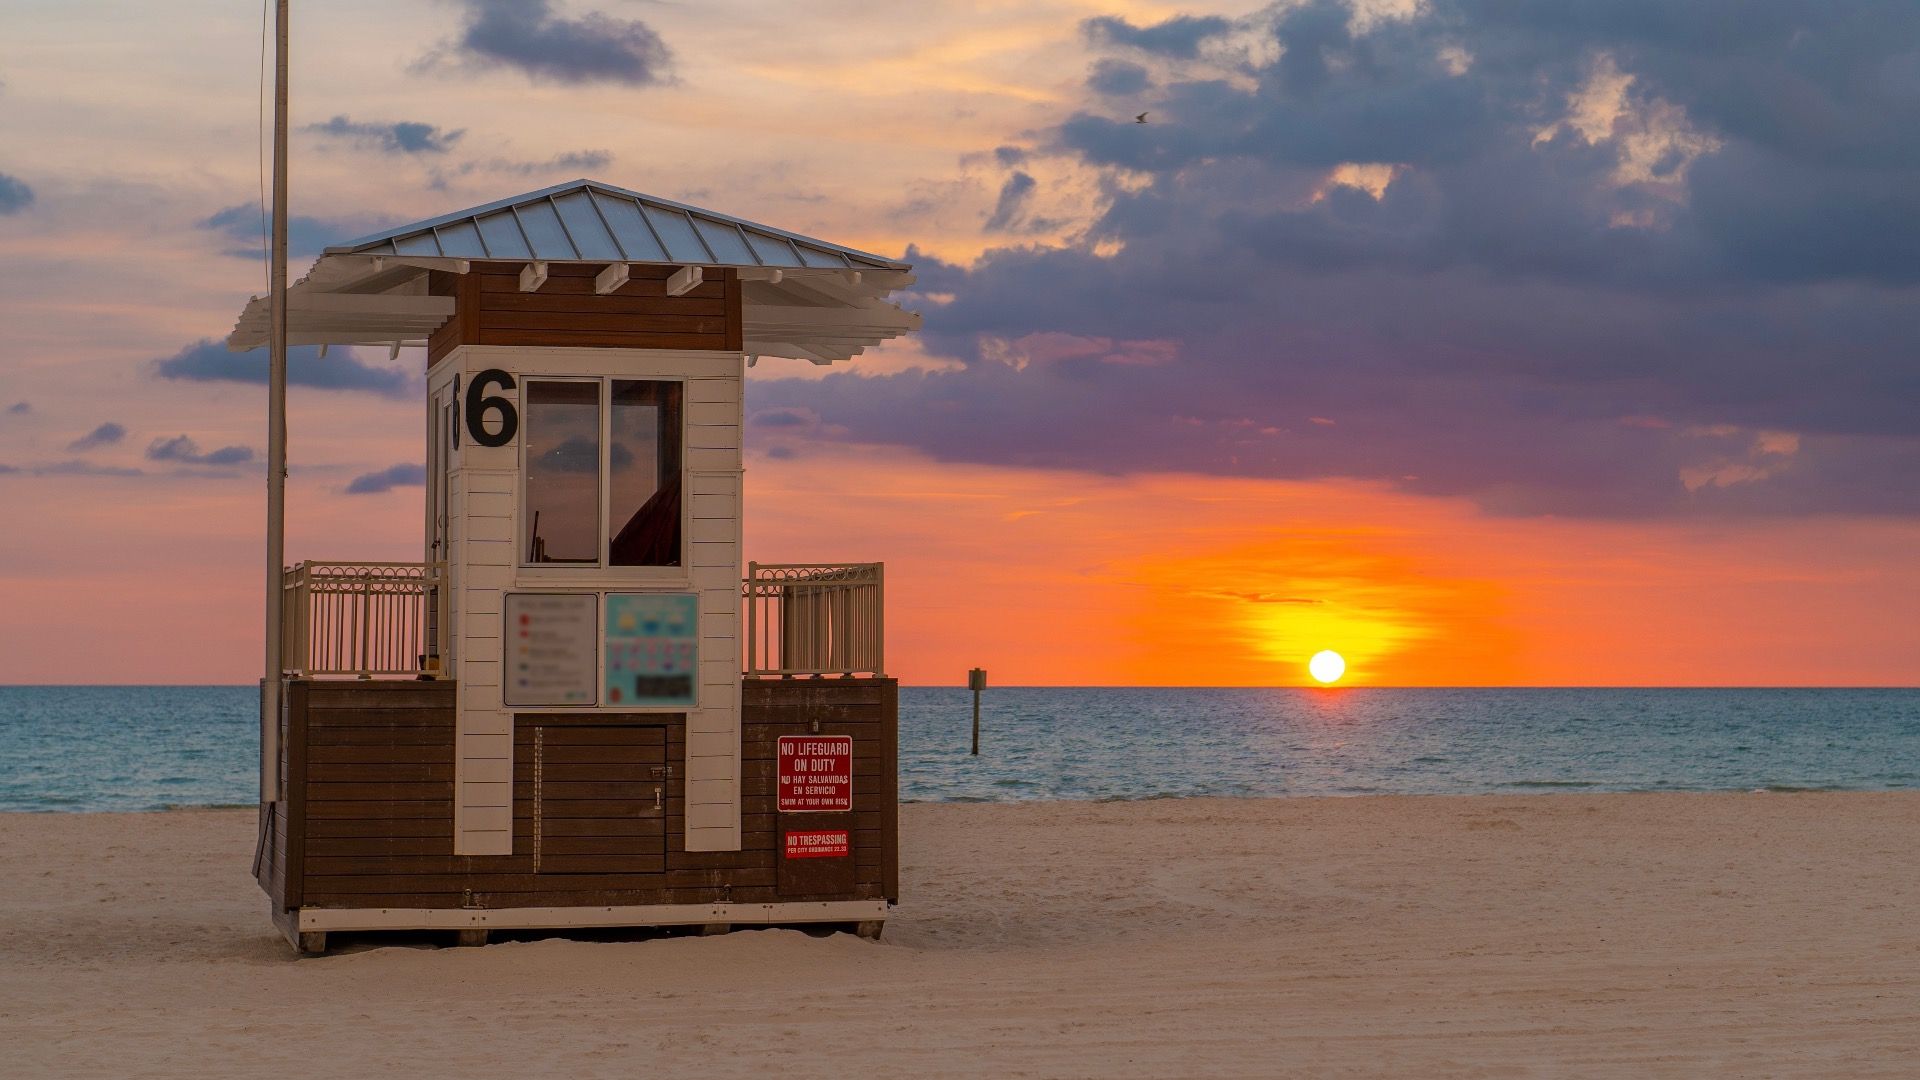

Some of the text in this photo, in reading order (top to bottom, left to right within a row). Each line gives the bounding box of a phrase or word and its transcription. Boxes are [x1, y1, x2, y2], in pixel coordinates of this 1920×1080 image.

[466, 369, 518, 447] 6
[781, 743, 849, 755] NO LIFEGUARD
[794, 758, 835, 771] ON DUTY
[781, 775, 848, 784] NO HAY SALVAVIDAS
[794, 786, 836, 795] EN SERVICIO
[787, 834, 847, 846] NO TRESPASSING
